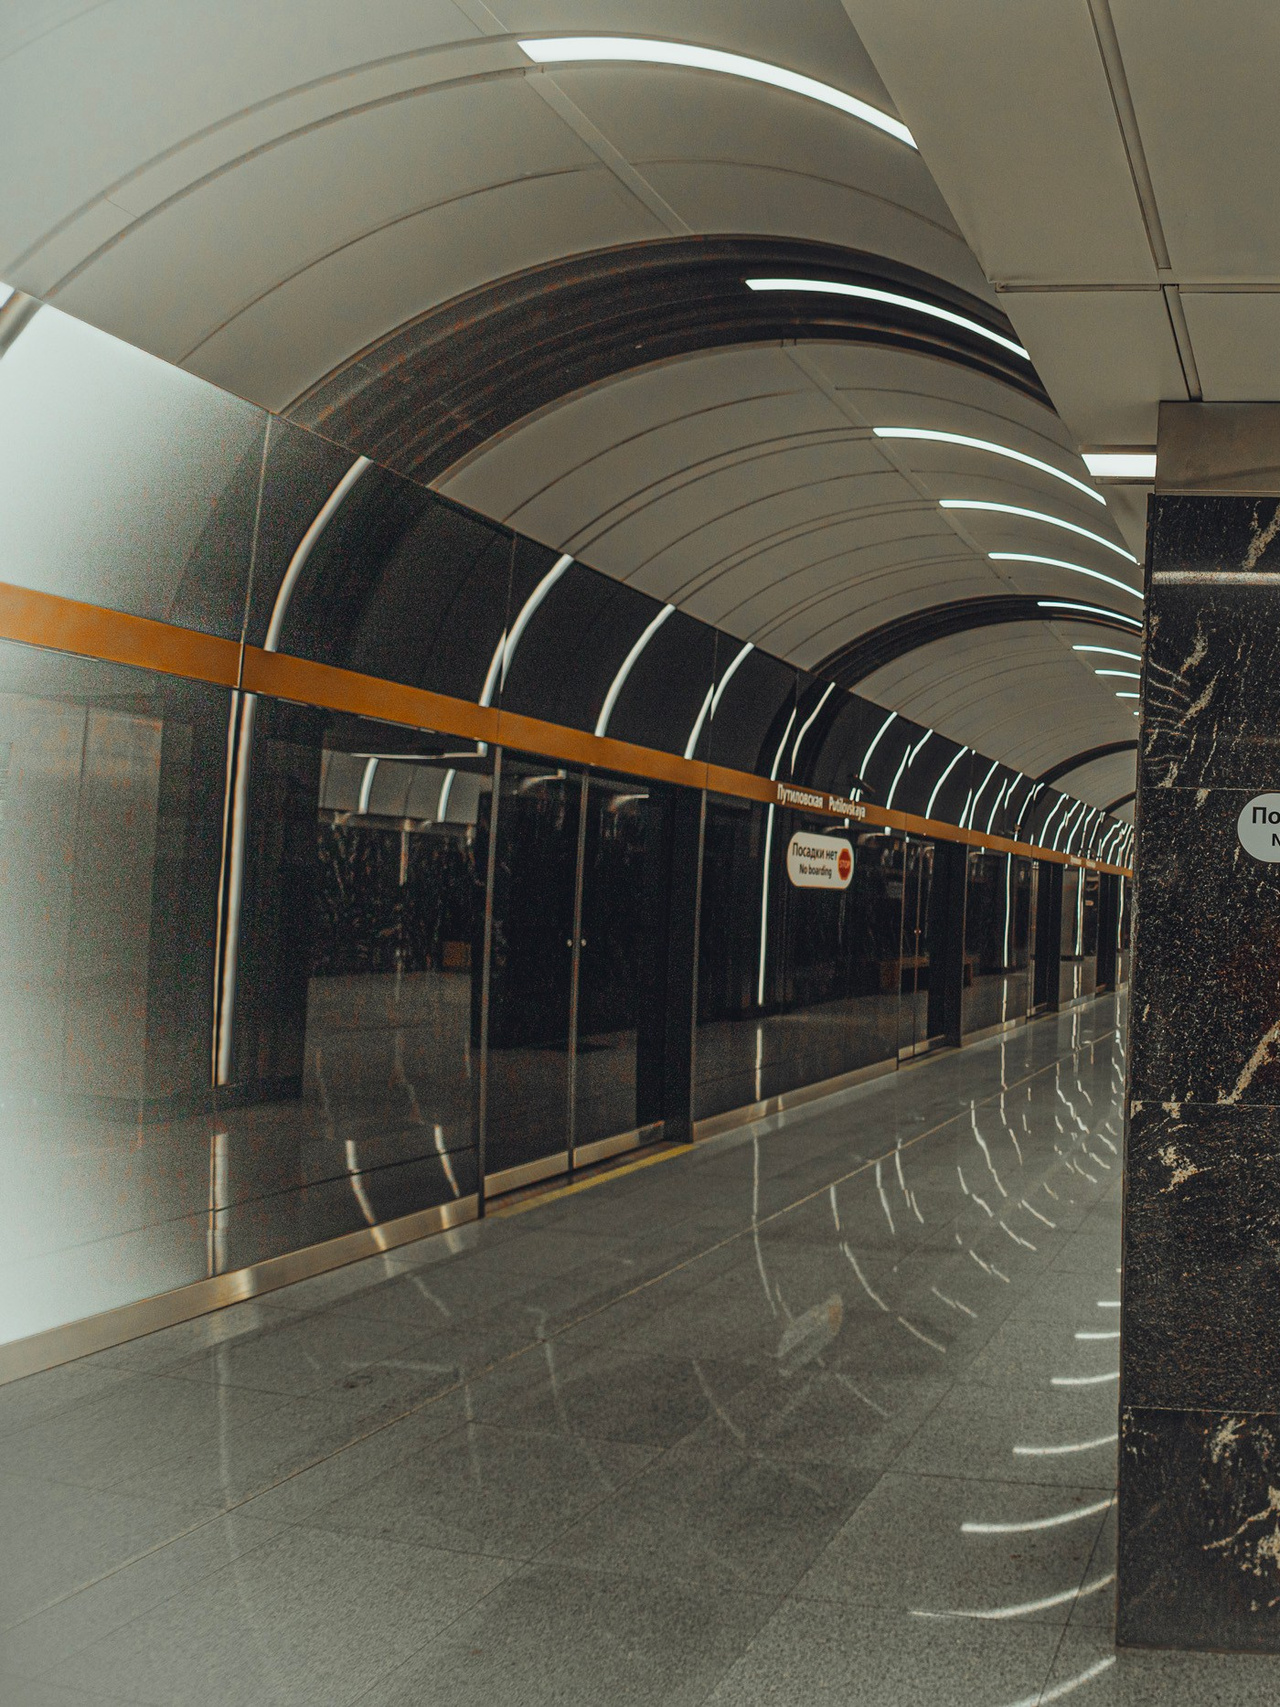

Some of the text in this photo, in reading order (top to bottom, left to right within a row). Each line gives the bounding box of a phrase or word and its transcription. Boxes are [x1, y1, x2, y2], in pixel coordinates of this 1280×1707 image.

[777, 784, 824, 810] Путиловская
[828, 796, 867, 822] Putilovskaya
[792, 842, 838, 861] Посадки нет
[799, 864, 833, 879] No boarding
